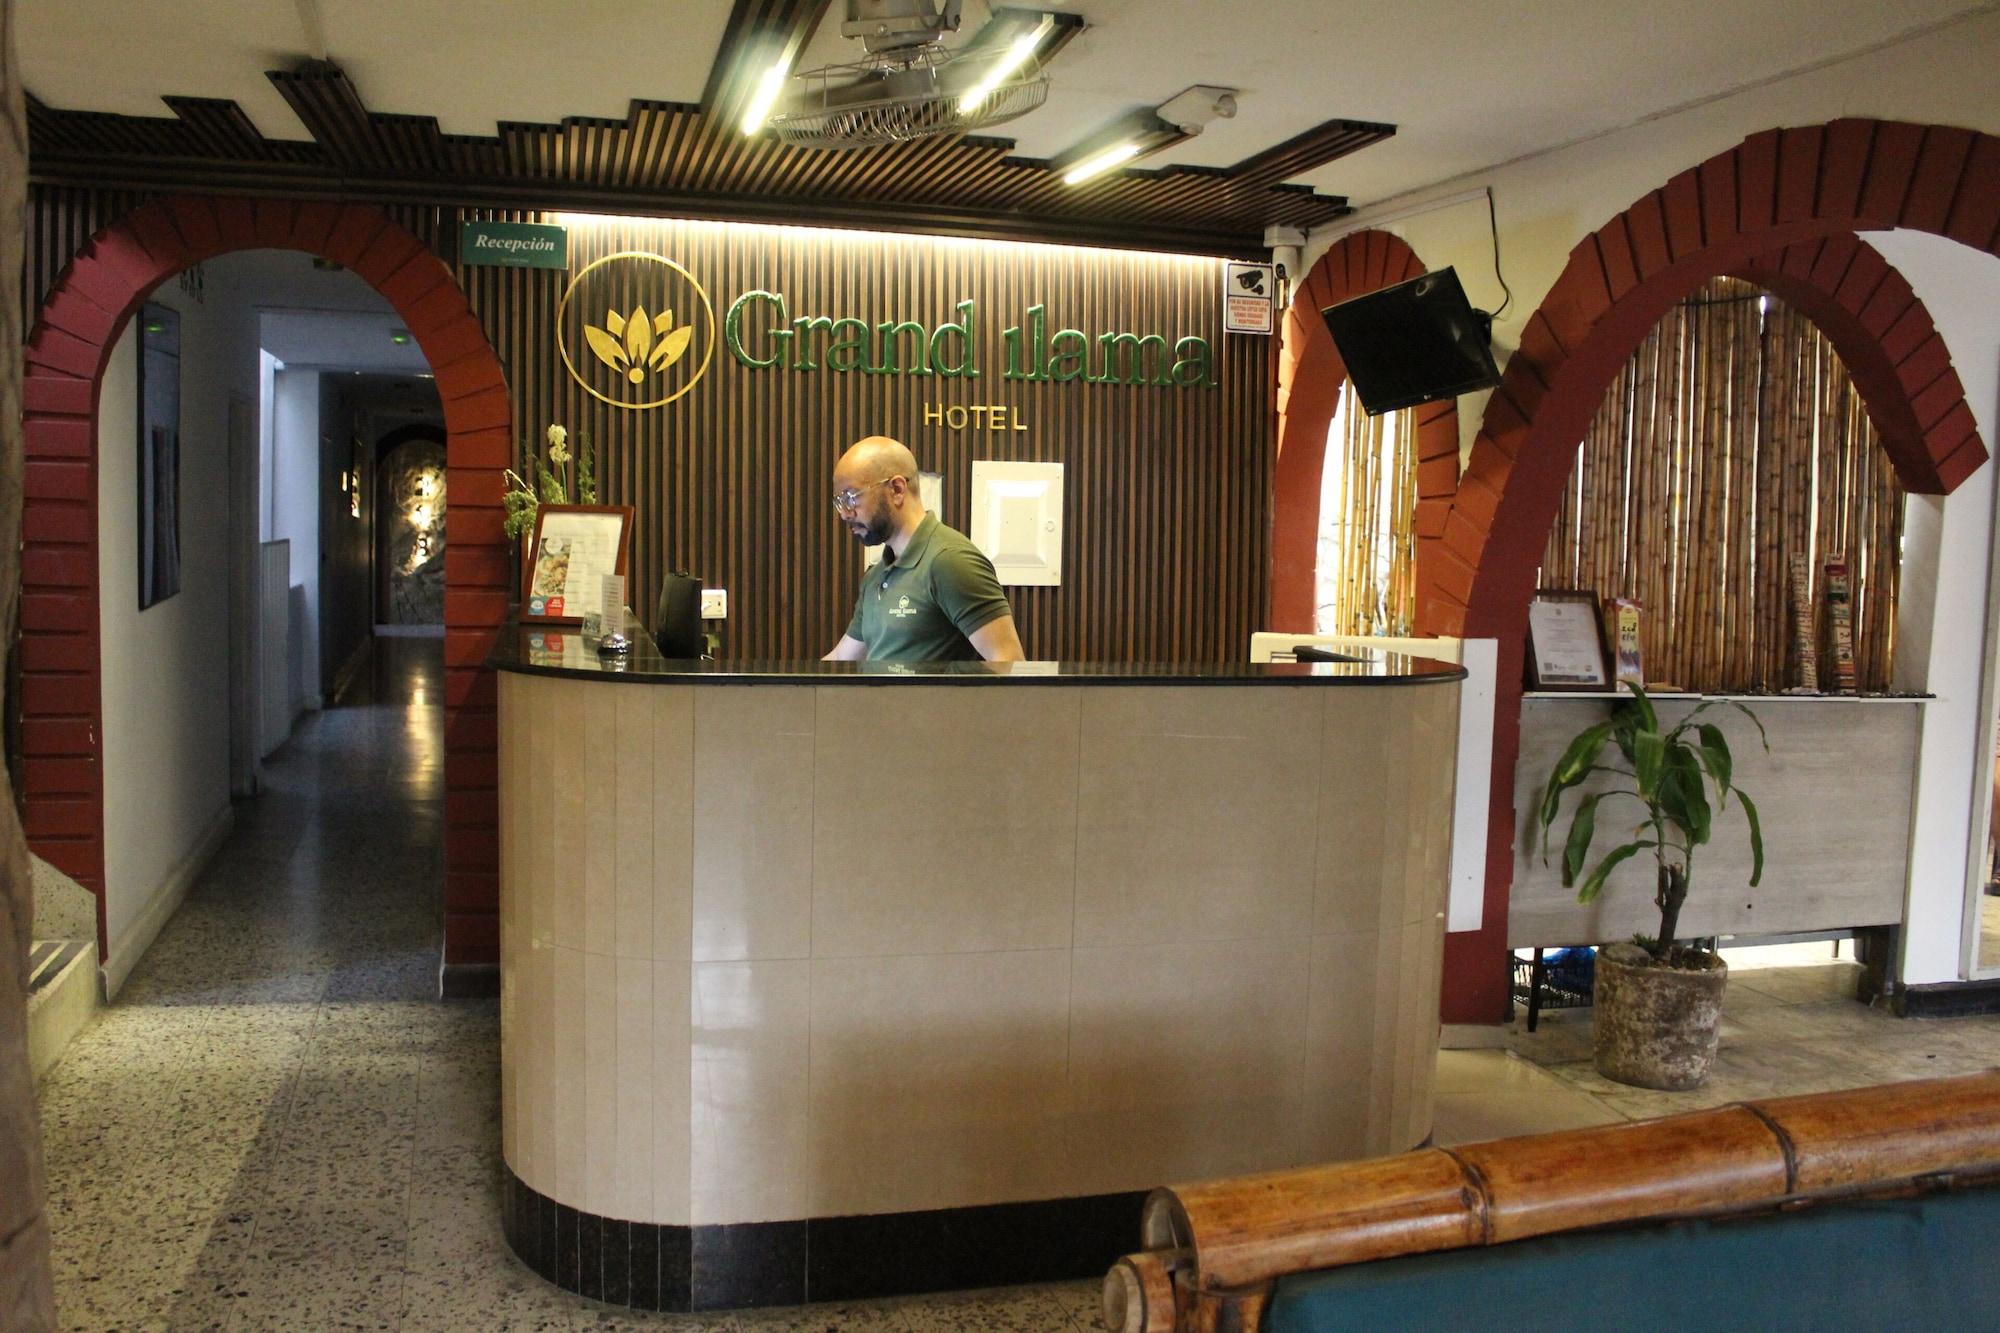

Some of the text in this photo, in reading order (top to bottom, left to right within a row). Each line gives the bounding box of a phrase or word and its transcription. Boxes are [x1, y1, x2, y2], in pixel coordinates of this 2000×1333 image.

[475, 234, 554, 252] Recepción
[725, 289, 980, 378] Grand
[923, 402, 1028, 431] HOTEL
